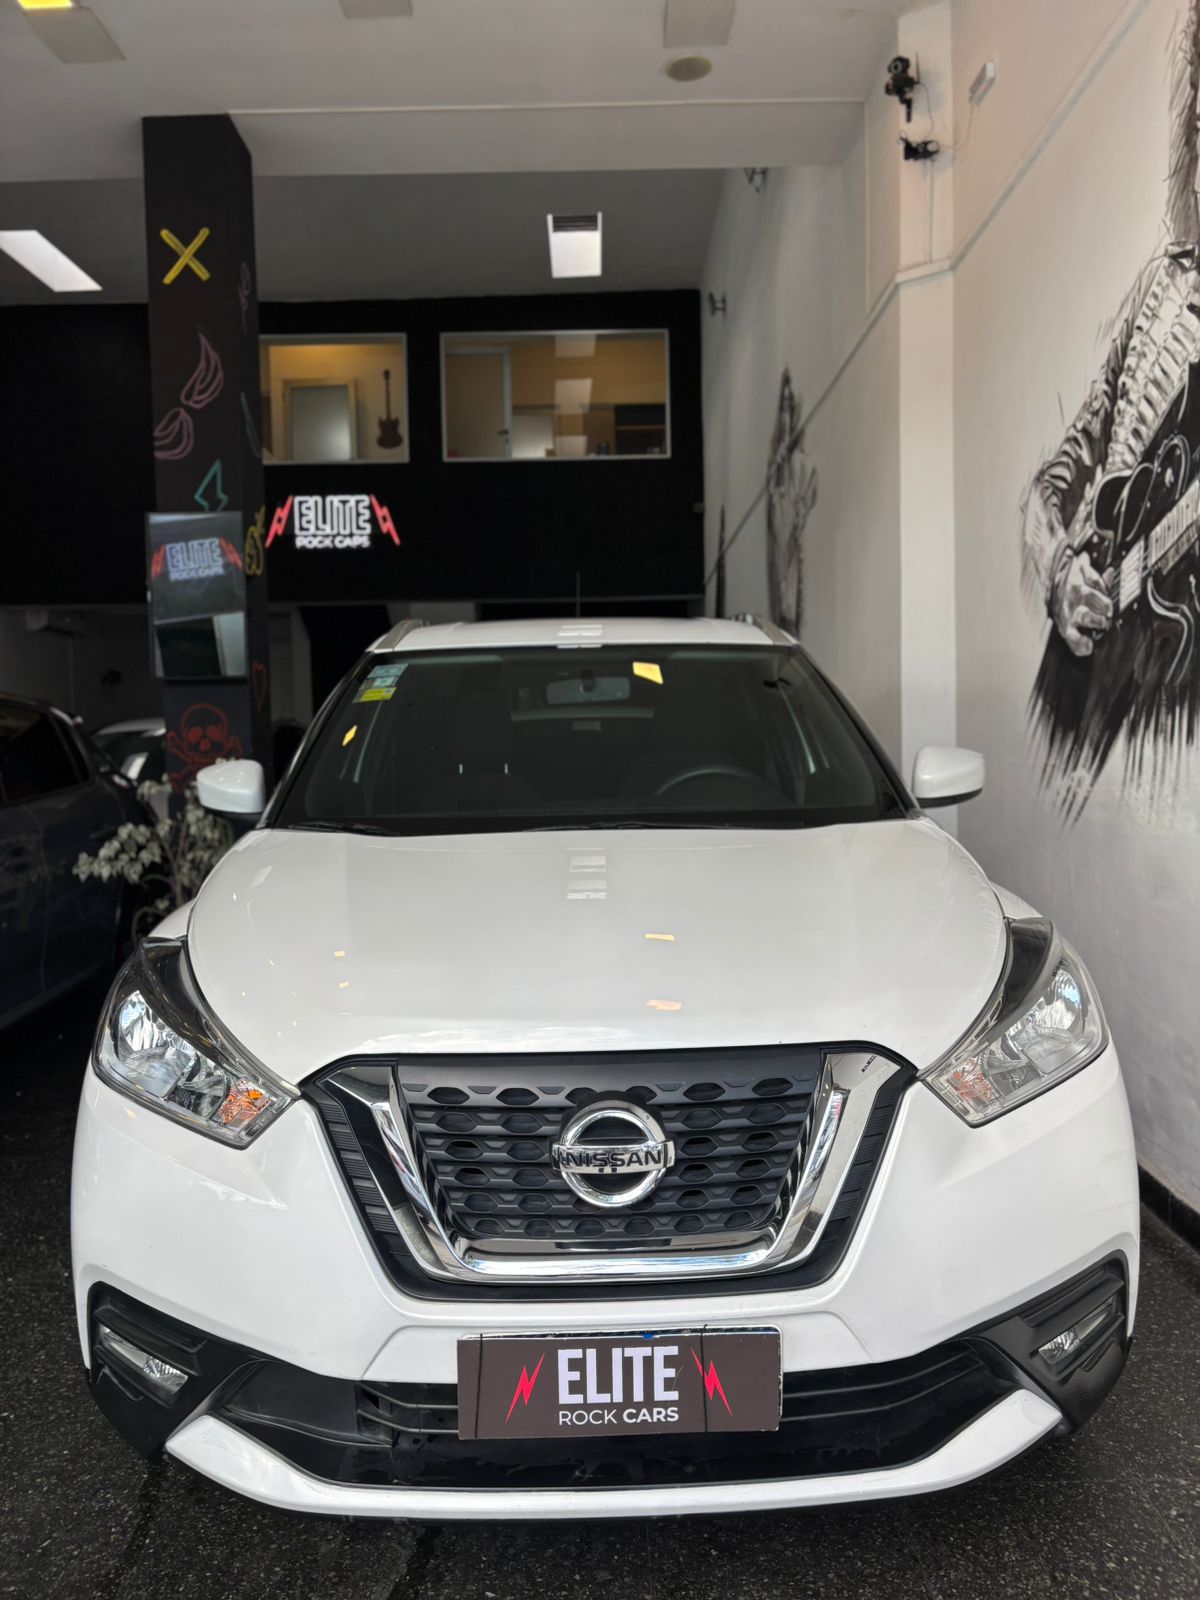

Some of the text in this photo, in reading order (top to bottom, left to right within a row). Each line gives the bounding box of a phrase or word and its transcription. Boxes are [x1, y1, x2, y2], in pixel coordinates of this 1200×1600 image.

[294, 495, 371, 535] ELITE
[165, 538, 222, 571] ELITE
[565, 1150, 662, 1168] NISSAN
[557, 1345, 679, 1405] ELITE
[558, 1406, 679, 1426] ROCK CARS
